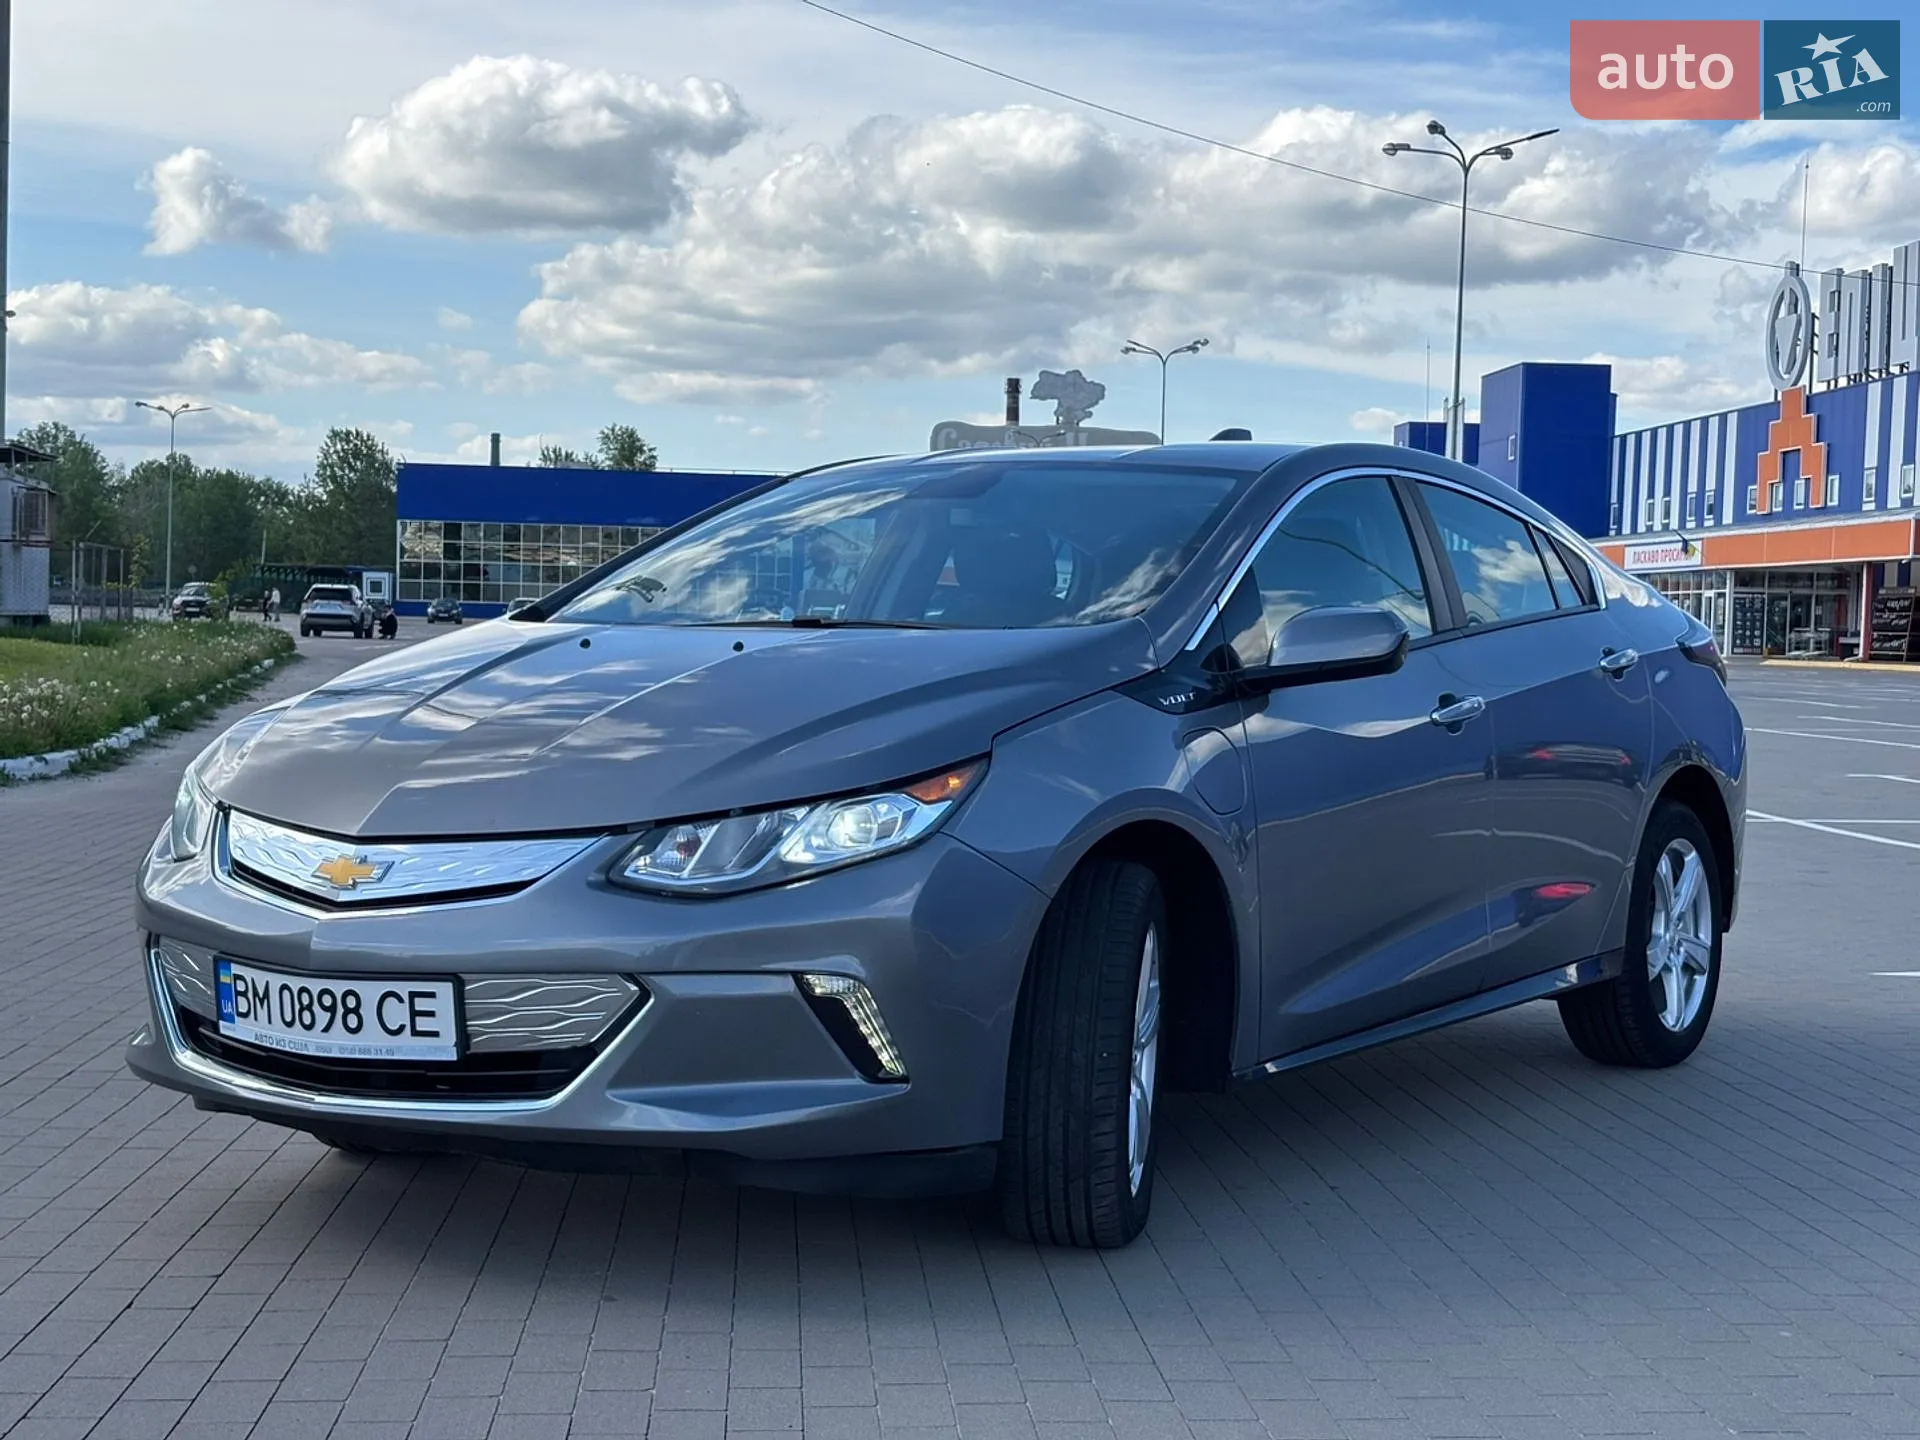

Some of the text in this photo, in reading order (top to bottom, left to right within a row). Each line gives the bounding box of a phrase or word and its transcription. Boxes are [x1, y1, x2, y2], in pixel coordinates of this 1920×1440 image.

[1158, 691, 1197, 705] VOLT
[233, 973, 440, 1037] BM 0898 CE
